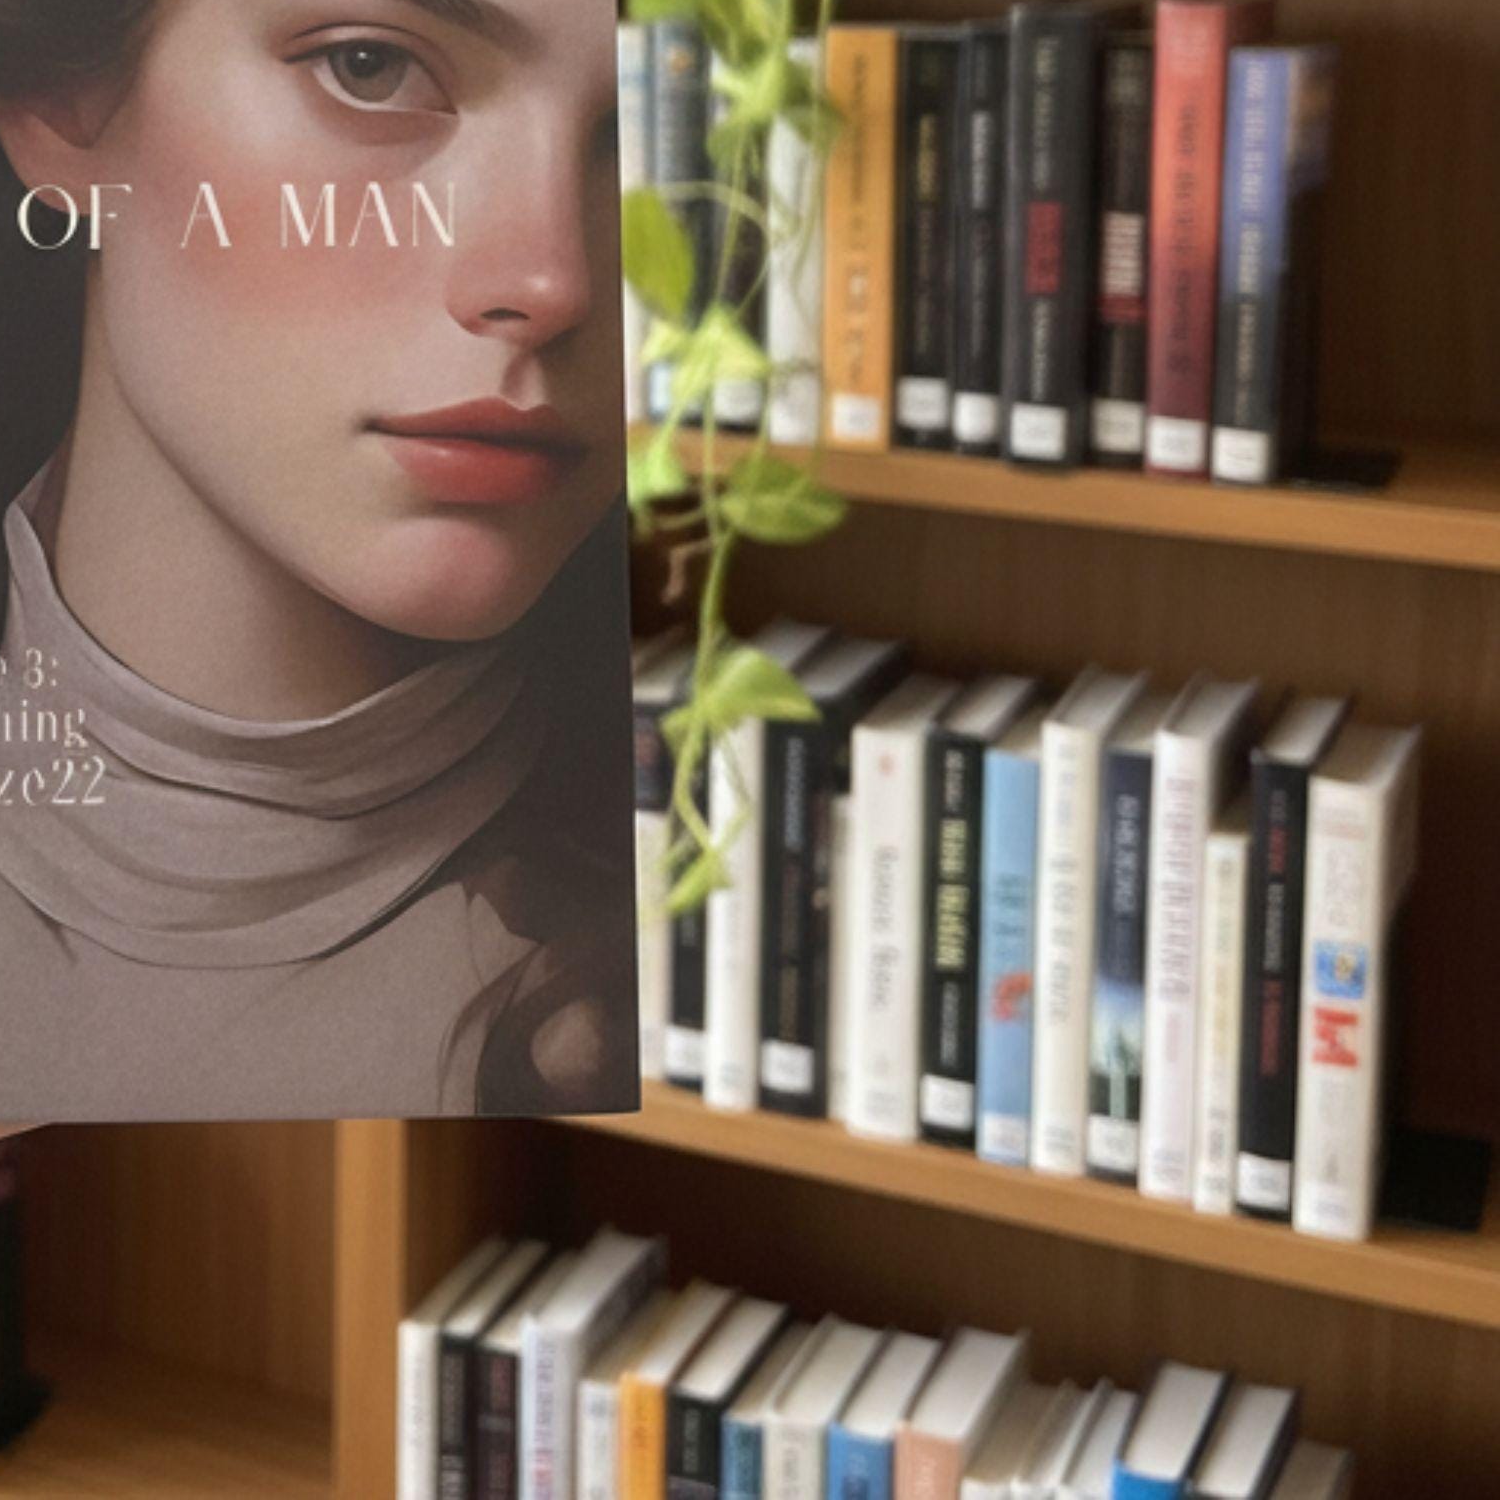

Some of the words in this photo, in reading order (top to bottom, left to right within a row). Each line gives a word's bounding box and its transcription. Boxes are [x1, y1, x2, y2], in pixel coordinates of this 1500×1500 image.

[17, 183, 133, 250] OF
[180, 181, 232, 249] A
[280, 180, 456, 249] MAN
[23, 647, 59, 690] 3:
